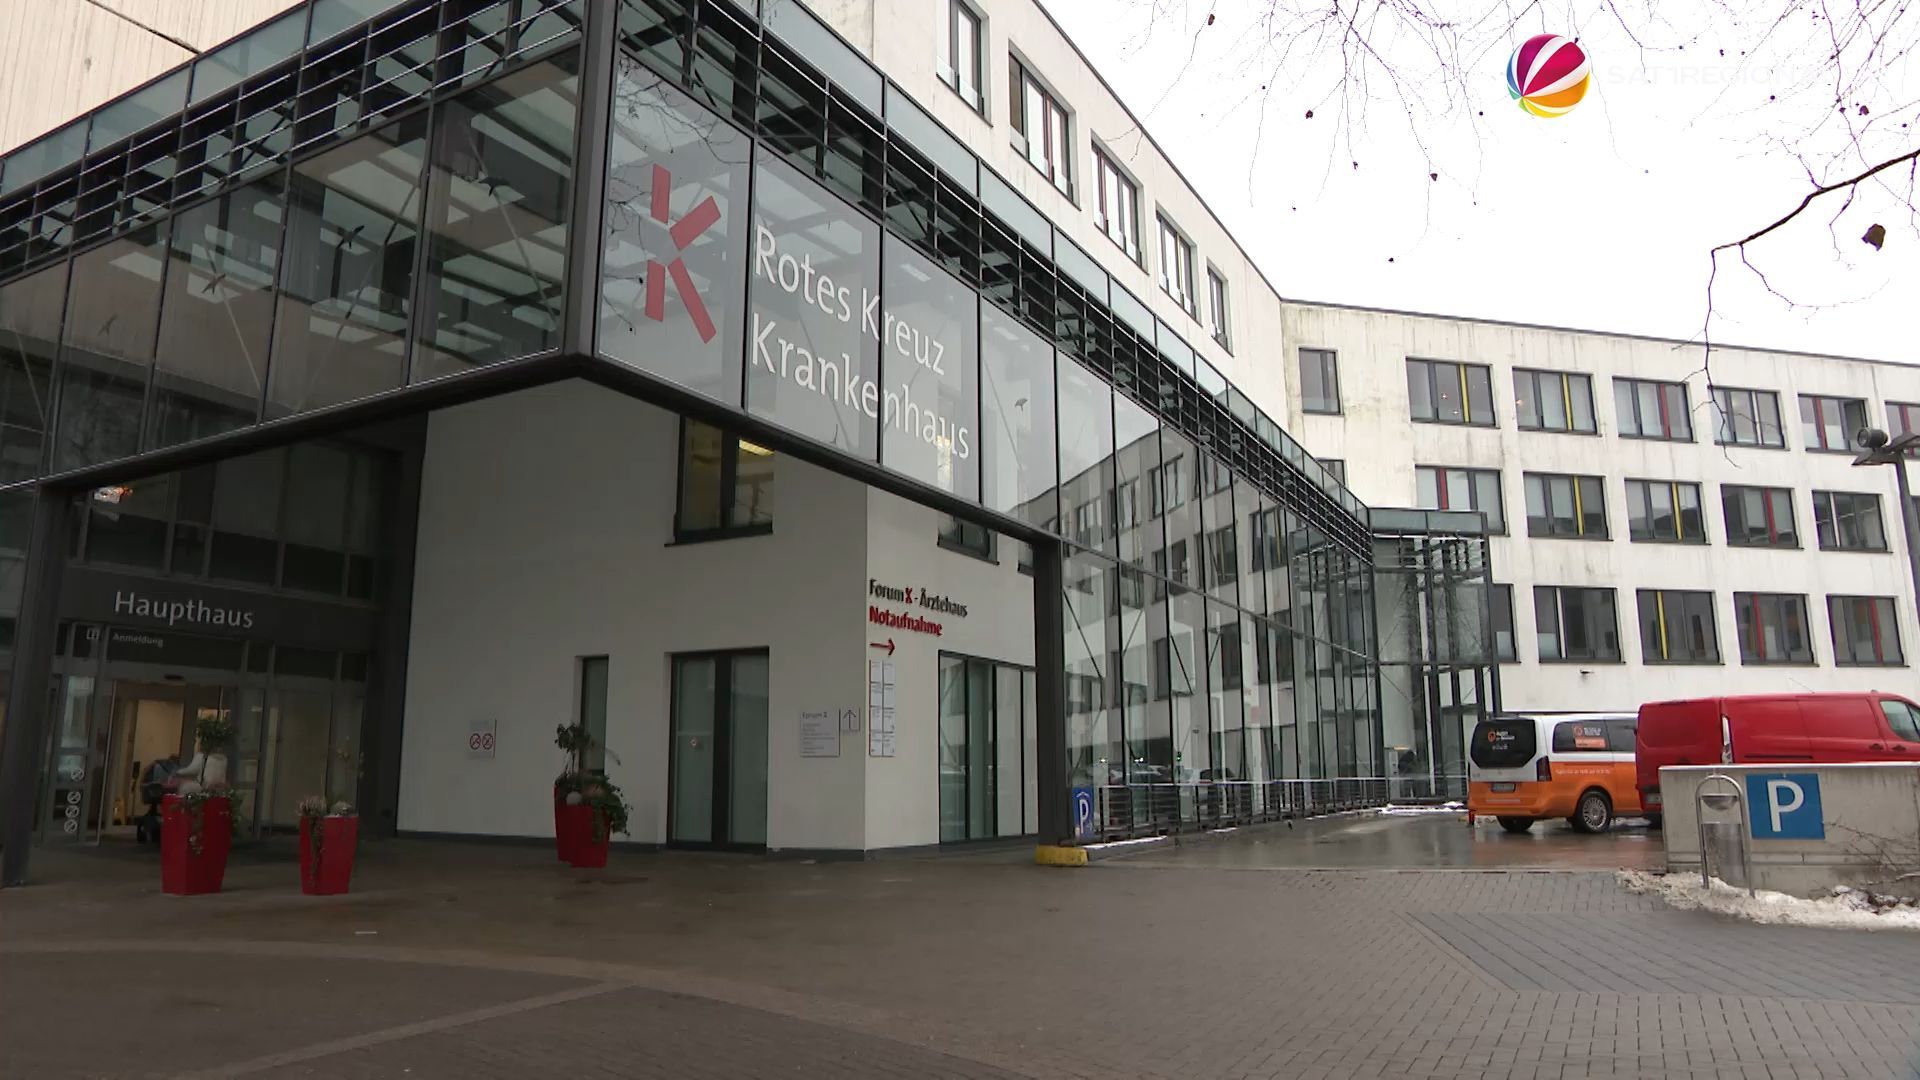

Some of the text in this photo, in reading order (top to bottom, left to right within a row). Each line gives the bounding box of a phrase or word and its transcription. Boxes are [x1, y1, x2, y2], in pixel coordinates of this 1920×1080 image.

[754, 224, 945, 376] Rotes Kreuz
[752, 312, 970, 460] Krankenhaus
[114, 590, 253, 629] Haupthaus
[869, 579, 904, 602] Forum
[919, 587, 968, 618] Ärztehaus
[869, 605, 942, 637] Notaufnahme
[1767, 780, 1805, 832] P
